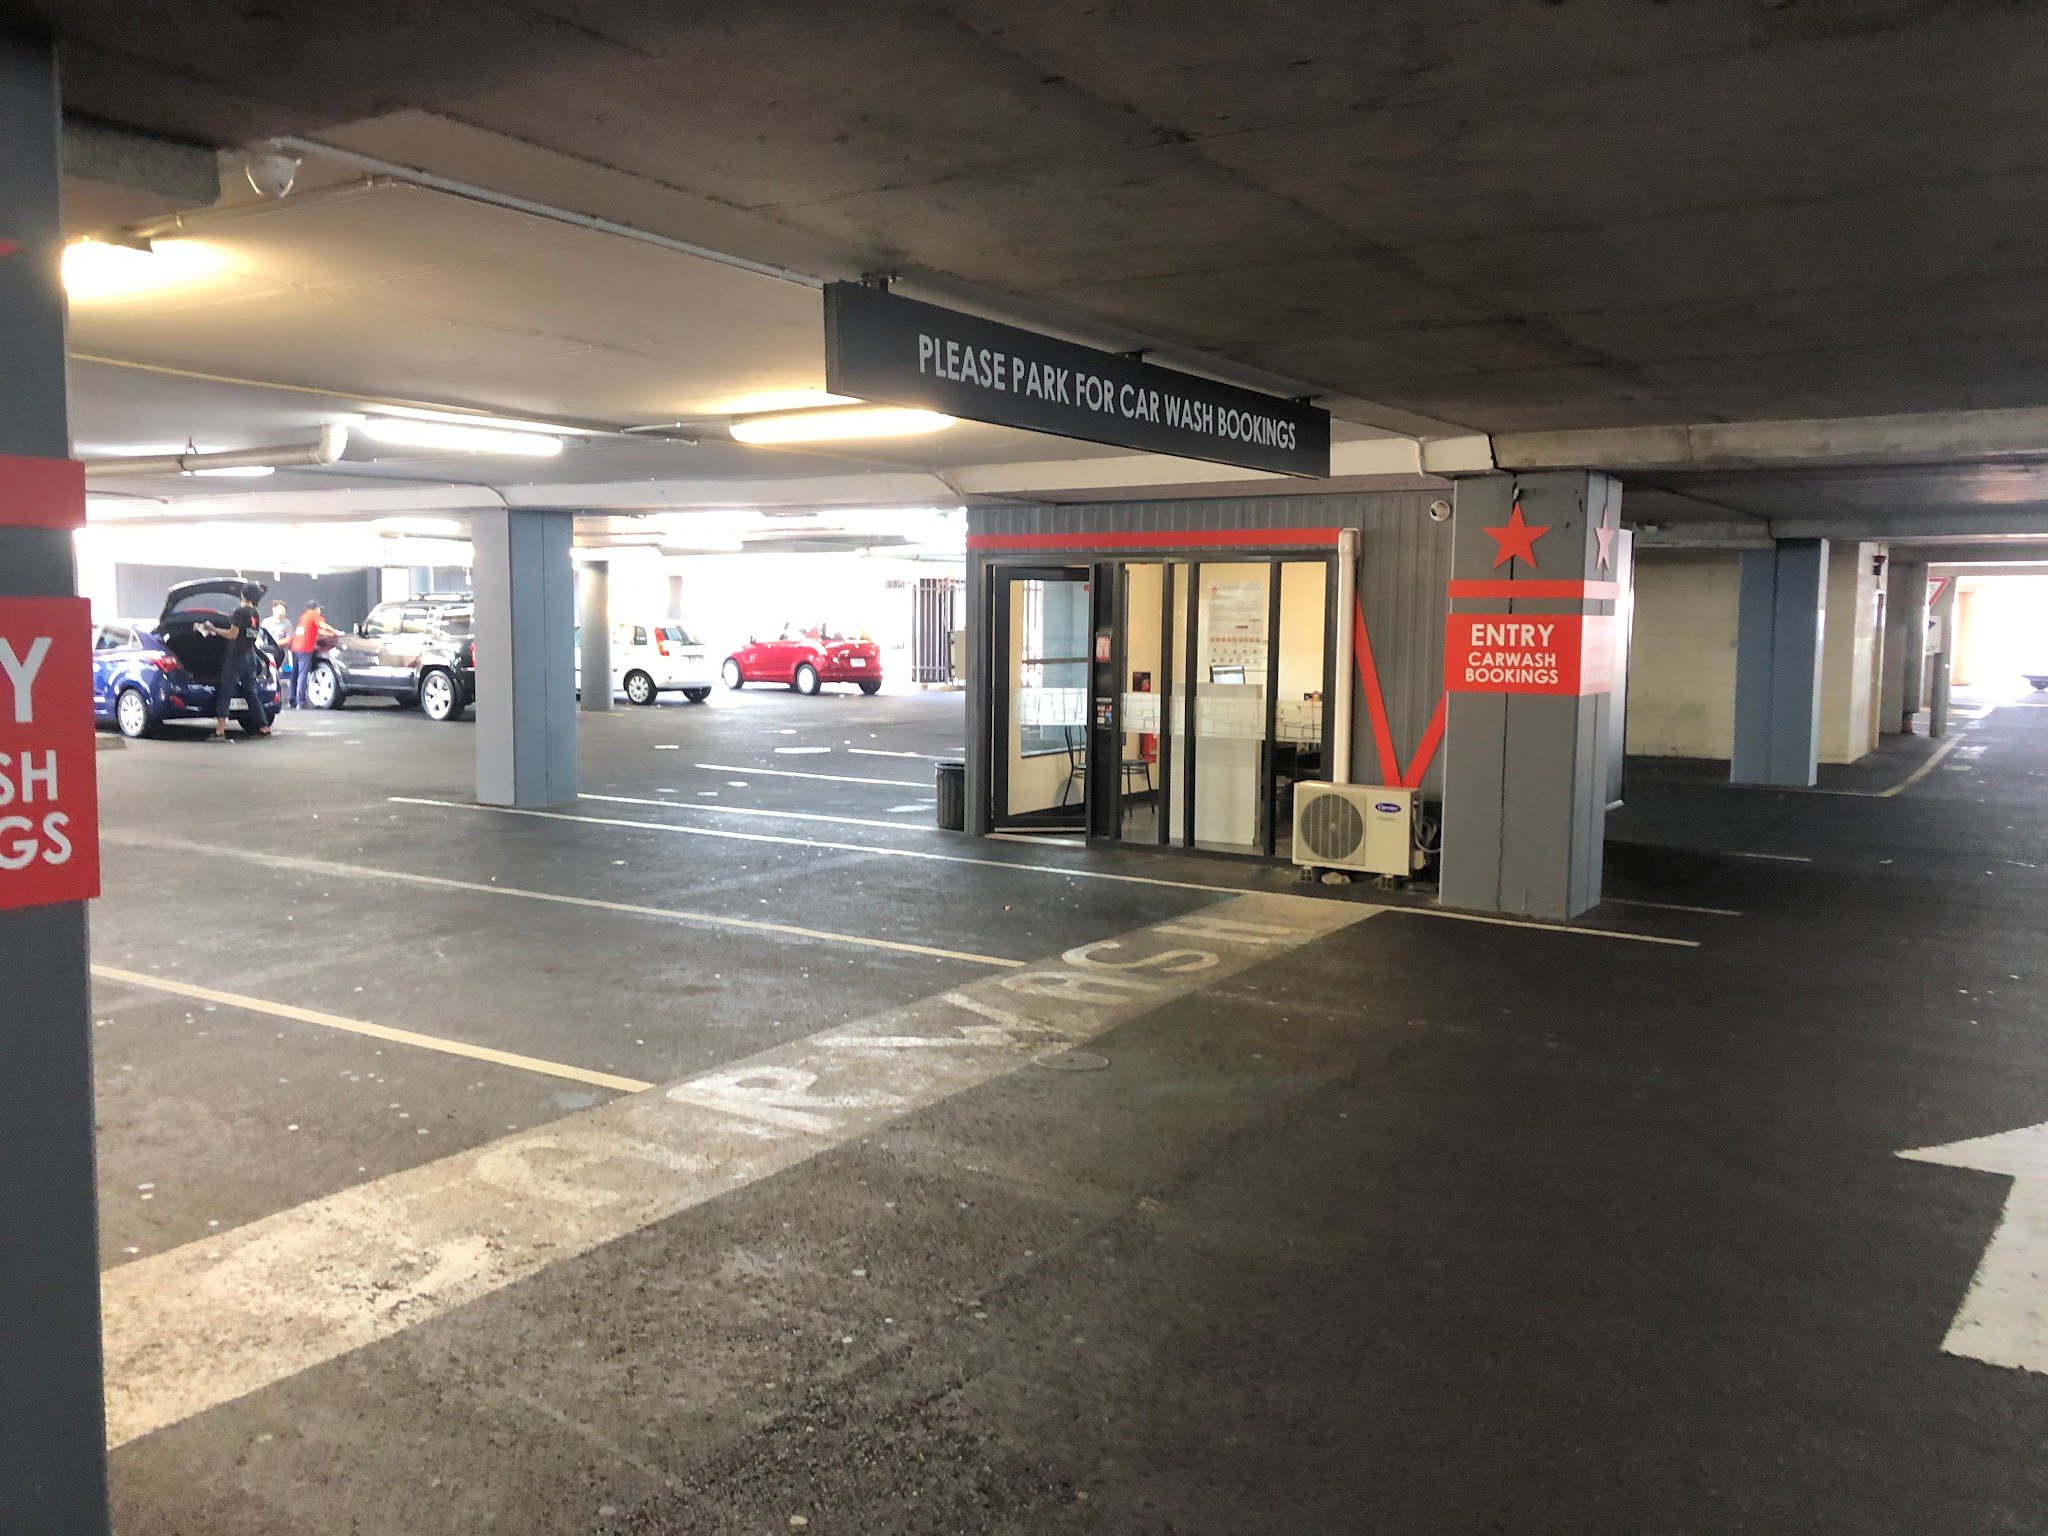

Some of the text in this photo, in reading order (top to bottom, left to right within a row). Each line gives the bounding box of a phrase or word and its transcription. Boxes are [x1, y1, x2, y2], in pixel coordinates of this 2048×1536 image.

[919, 334, 1296, 450] PLEASE PARK FOR CAR WASH BOOKINGS
[1471, 624, 1555, 647] ENTRY
[1468, 651, 1556, 668] CARWASH
[1465, 668, 1559, 684] BOOKINGS
